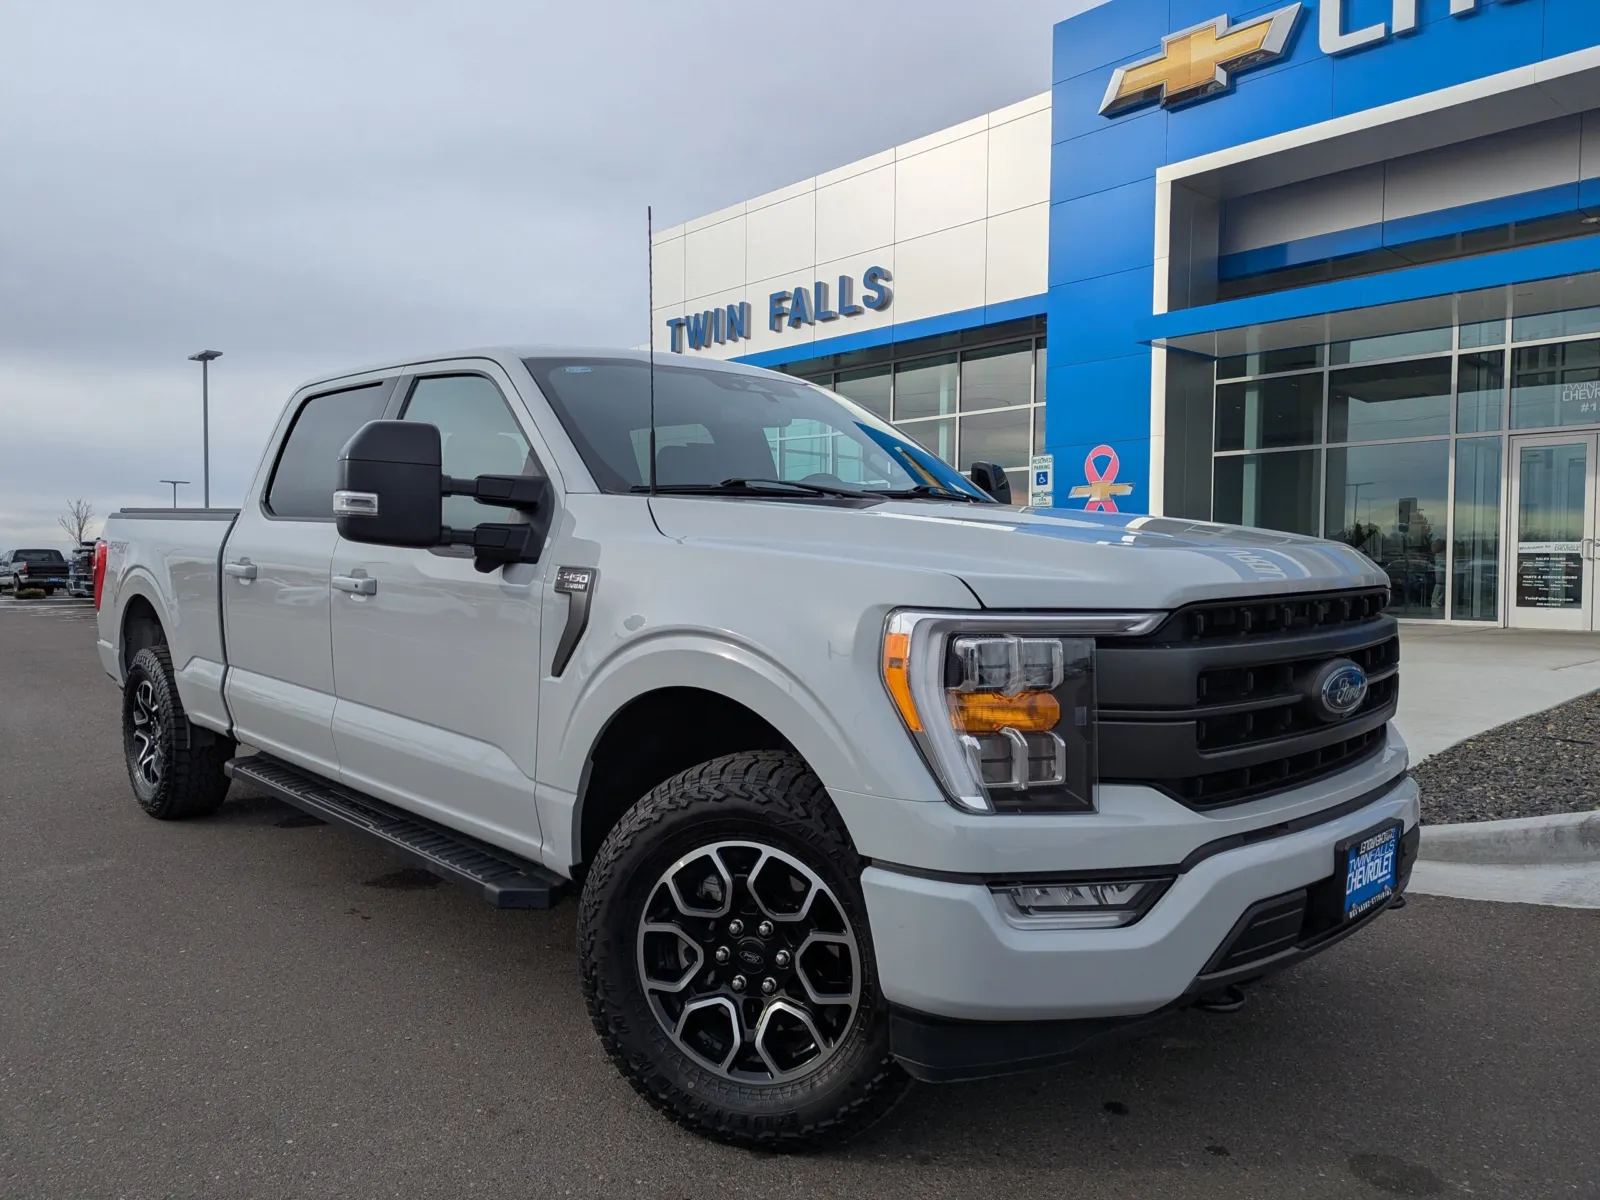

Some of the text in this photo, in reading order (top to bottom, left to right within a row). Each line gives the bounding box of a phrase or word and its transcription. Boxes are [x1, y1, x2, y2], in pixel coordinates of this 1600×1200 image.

[666, 266, 893, 354] TWIN FALLS
[1336, 677, 1361, 704] Ford
[1346, 852, 1393, 895] CHEVROLET
